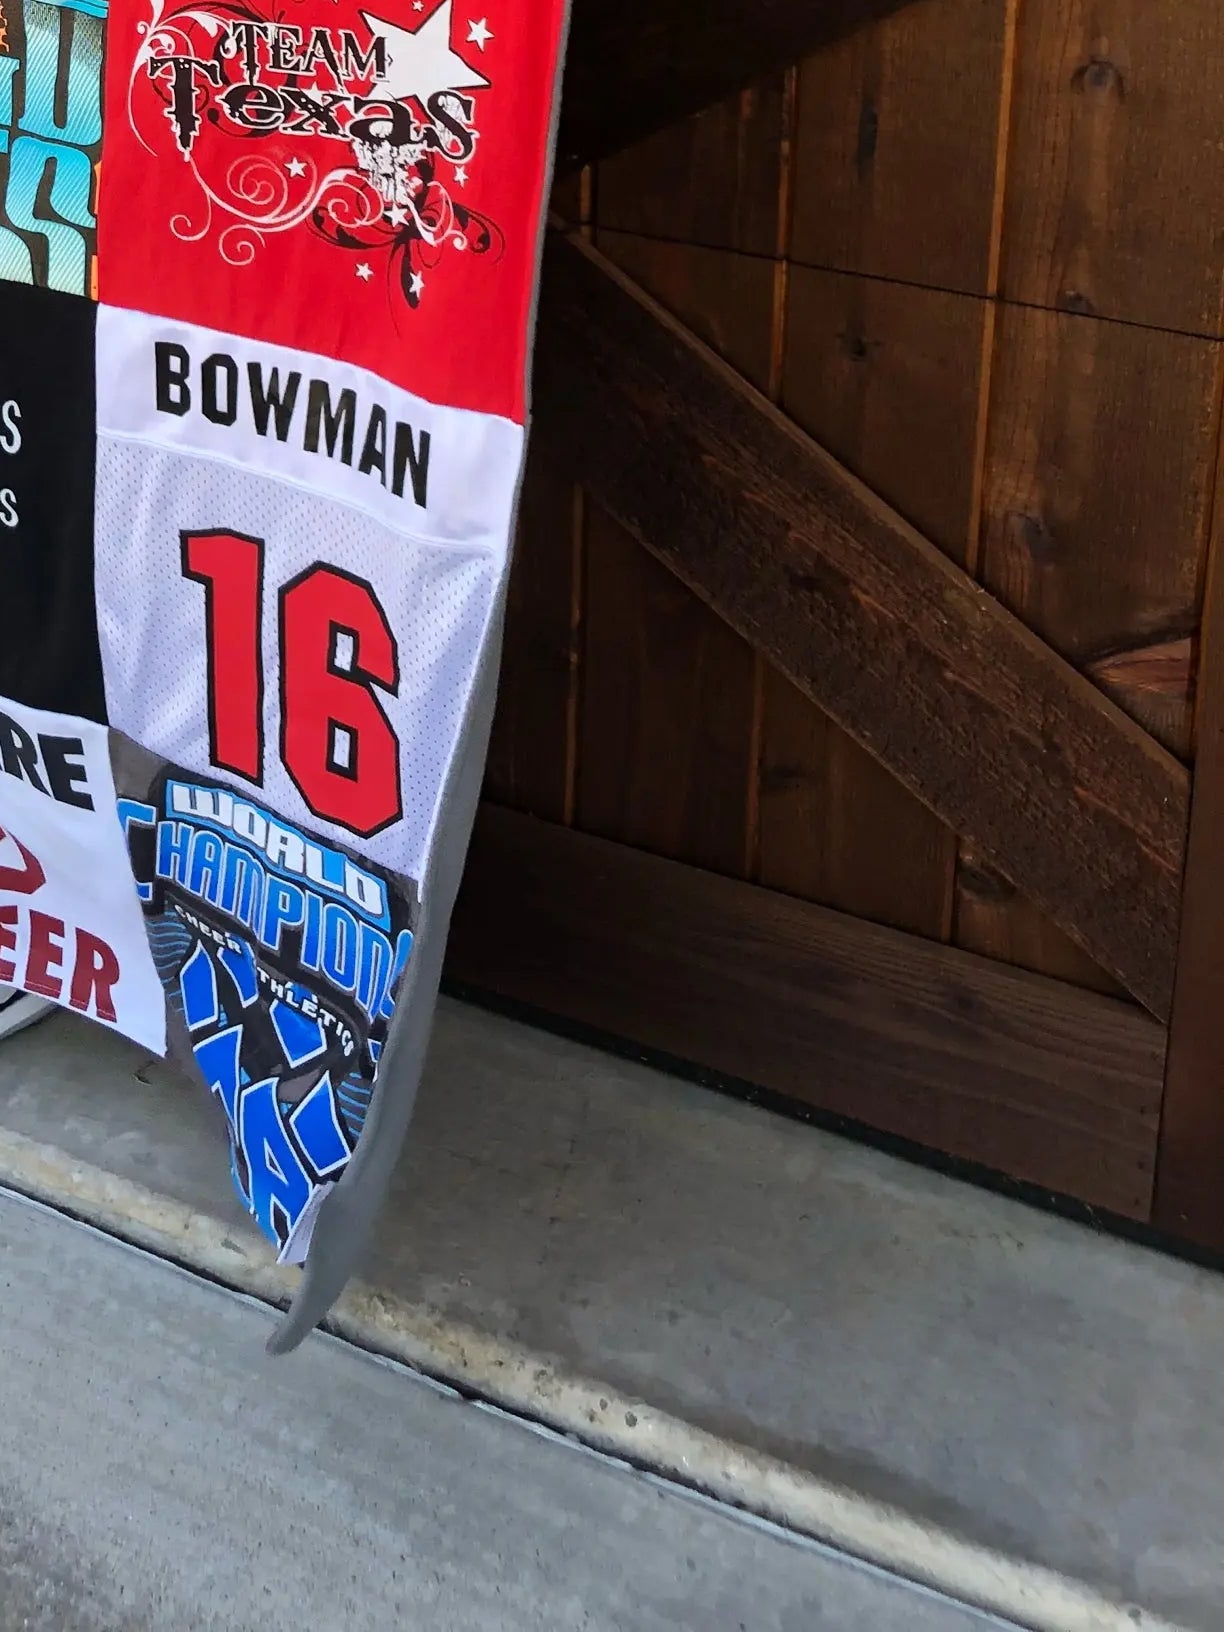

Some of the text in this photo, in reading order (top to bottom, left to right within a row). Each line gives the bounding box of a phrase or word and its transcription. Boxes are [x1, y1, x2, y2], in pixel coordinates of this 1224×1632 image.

[148, 56, 479, 163] Texas
[229, 20, 391, 85] TEAM
[154, 341, 431, 509] BOWMAN
[180, 527, 404, 840] 16
[172, 784, 384, 917] WORLD
[174, 905, 355, 1057] CHEER THLETICS
